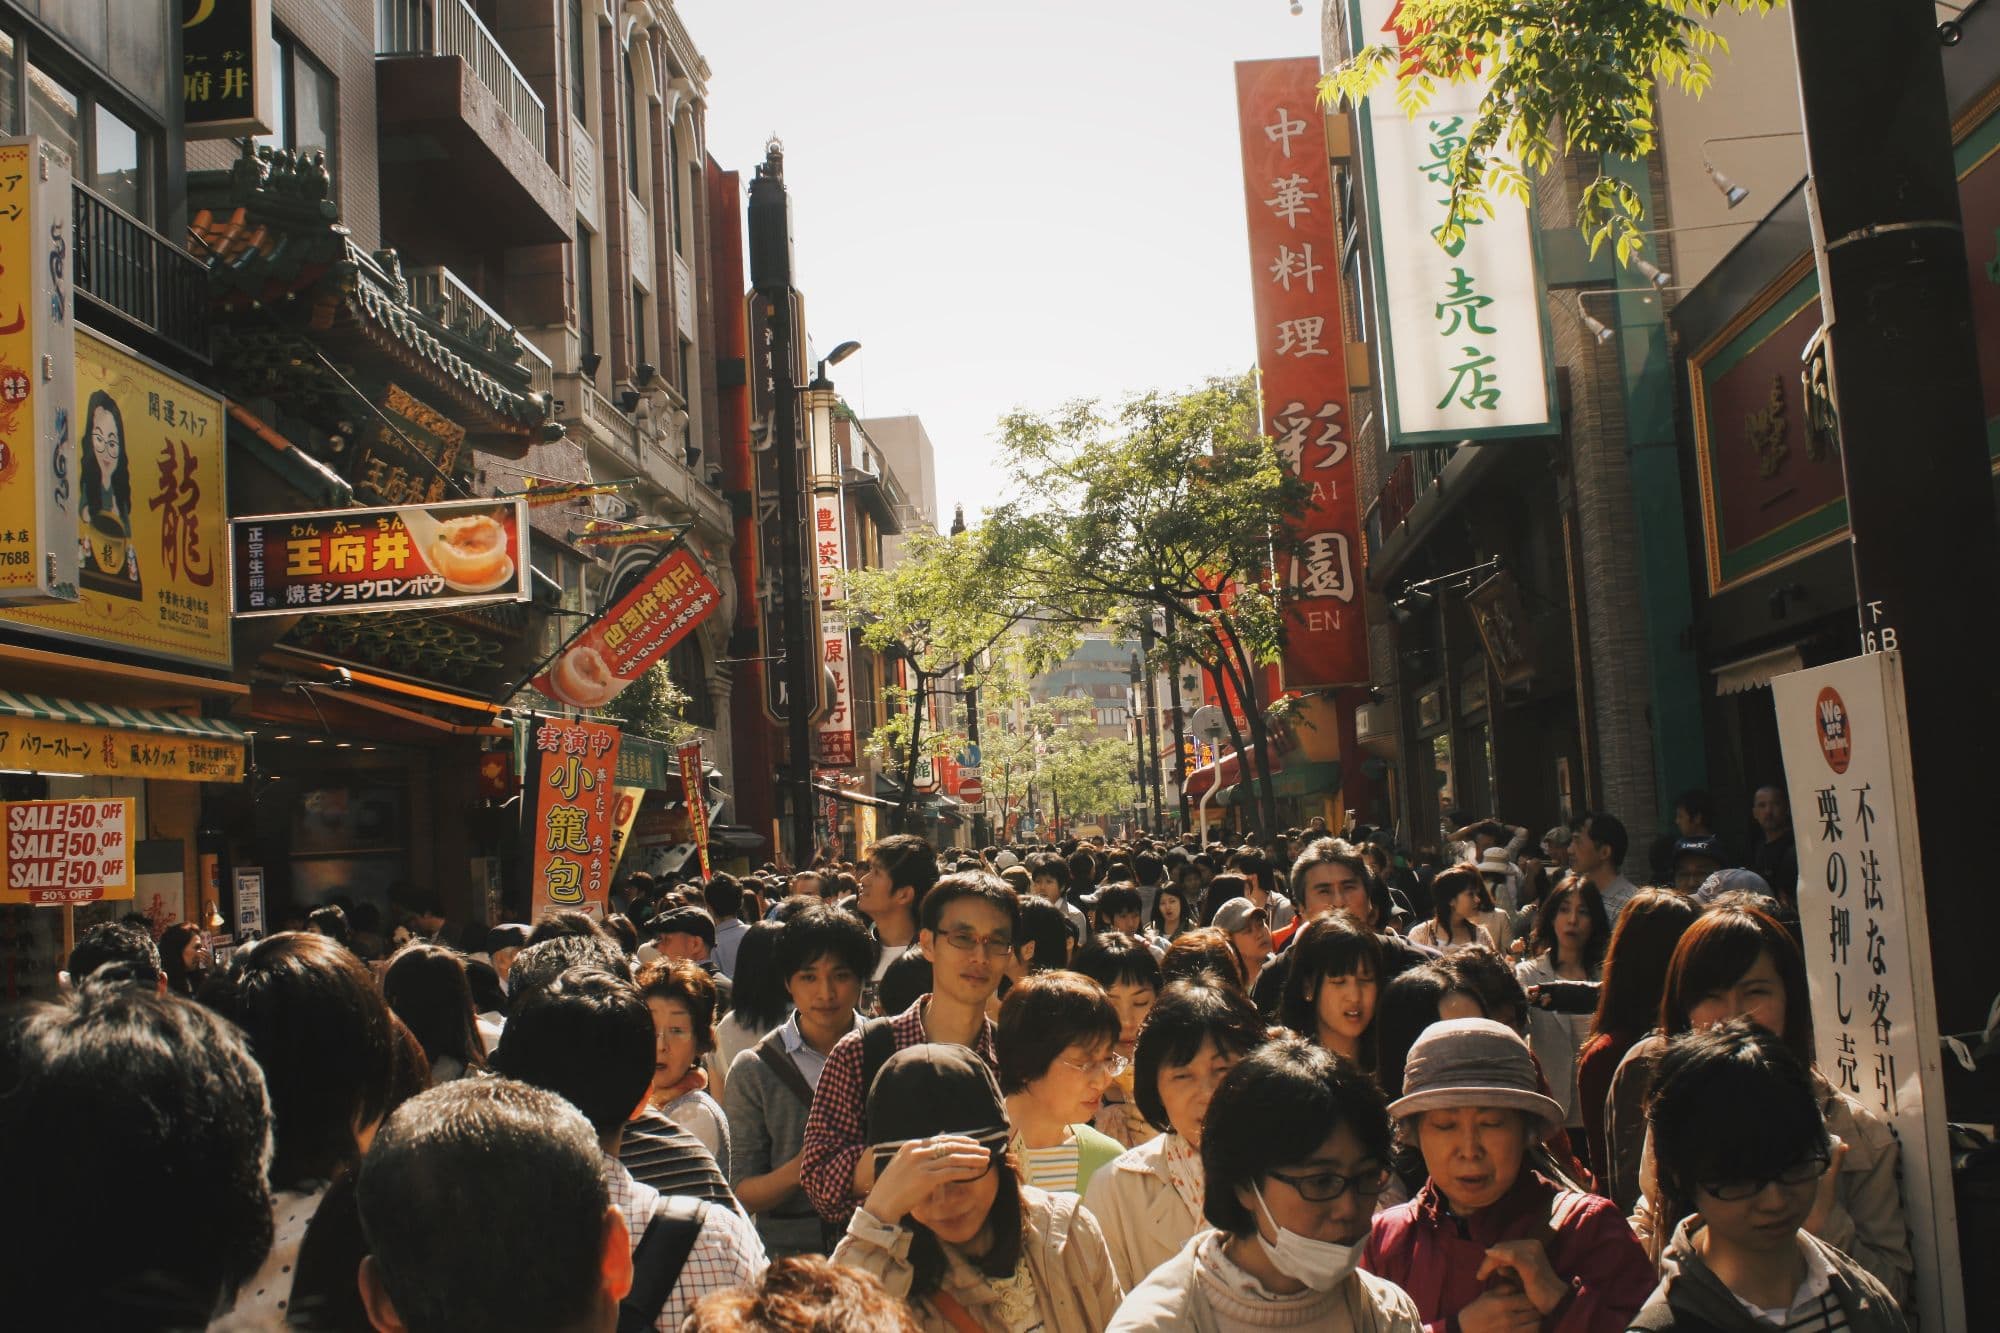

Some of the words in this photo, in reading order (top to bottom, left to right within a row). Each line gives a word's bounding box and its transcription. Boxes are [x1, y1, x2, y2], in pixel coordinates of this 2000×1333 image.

[1264, 107, 1329, 359] 中華料理
[1418, 116, 1501, 412] 菓子売店
[148, 391, 208, 438] 開運ストア
[1311, 480, 1338, 501] AI
[290, 523, 319, 537] わん
[333, 520, 361, 534] ふー
[378, 517, 406, 533] ちん
[286, 532, 411, 577] 王府井
[286, 574, 446, 604] 焼きショウロンポウ
[603, 561, 695, 648] 正宗生煎包
[1867, 601, 1883, 624] 下
[1308, 610, 1341, 632] EN
[1820, 700, 1842, 723] We
[537, 723, 613, 758] 実演中
[1826, 722, 1842, 736] are
[20, 732, 92, 760] パワーストーン
[130, 743, 177, 766] 風水グッズ
[595, 767, 608, 823] 蒸したて
[8, 804, 65, 832] SALE
[101, 803, 123, 820] OFF
[544, 755, 595, 905] 小籠包
[9, 832, 66, 860] SALE
[102, 831, 123, 848] OFF
[9, 861, 67, 889] SALE
[102, 859, 124, 876] OFF
[589, 836, 604, 891] あつあつの
[41, 890, 66, 900] 50%
[69, 890, 93, 900] OFF
